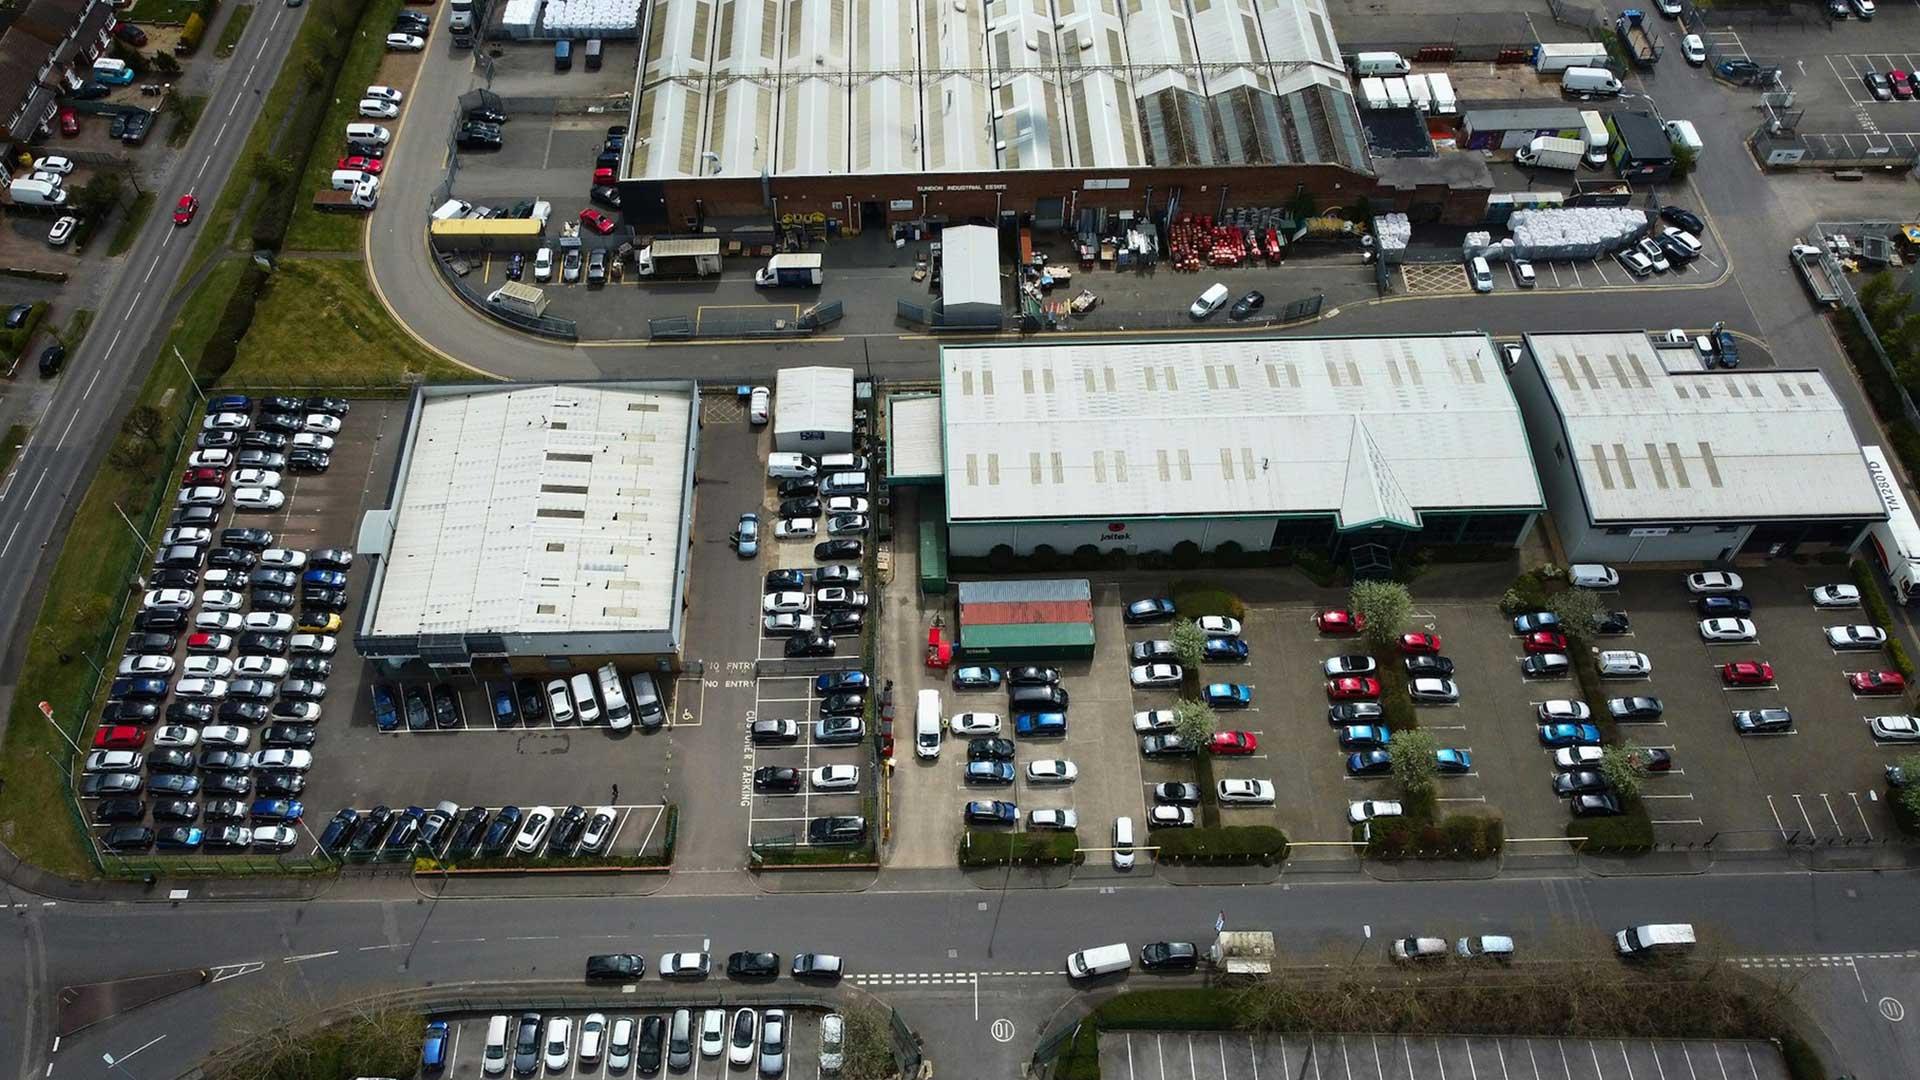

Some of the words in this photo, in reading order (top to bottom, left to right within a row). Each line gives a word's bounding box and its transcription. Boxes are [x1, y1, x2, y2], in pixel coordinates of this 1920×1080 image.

[705, 680, 719, 688] NO
[725, 680, 756, 688] ENTRY
[740, 765, 752, 807] PARKING
